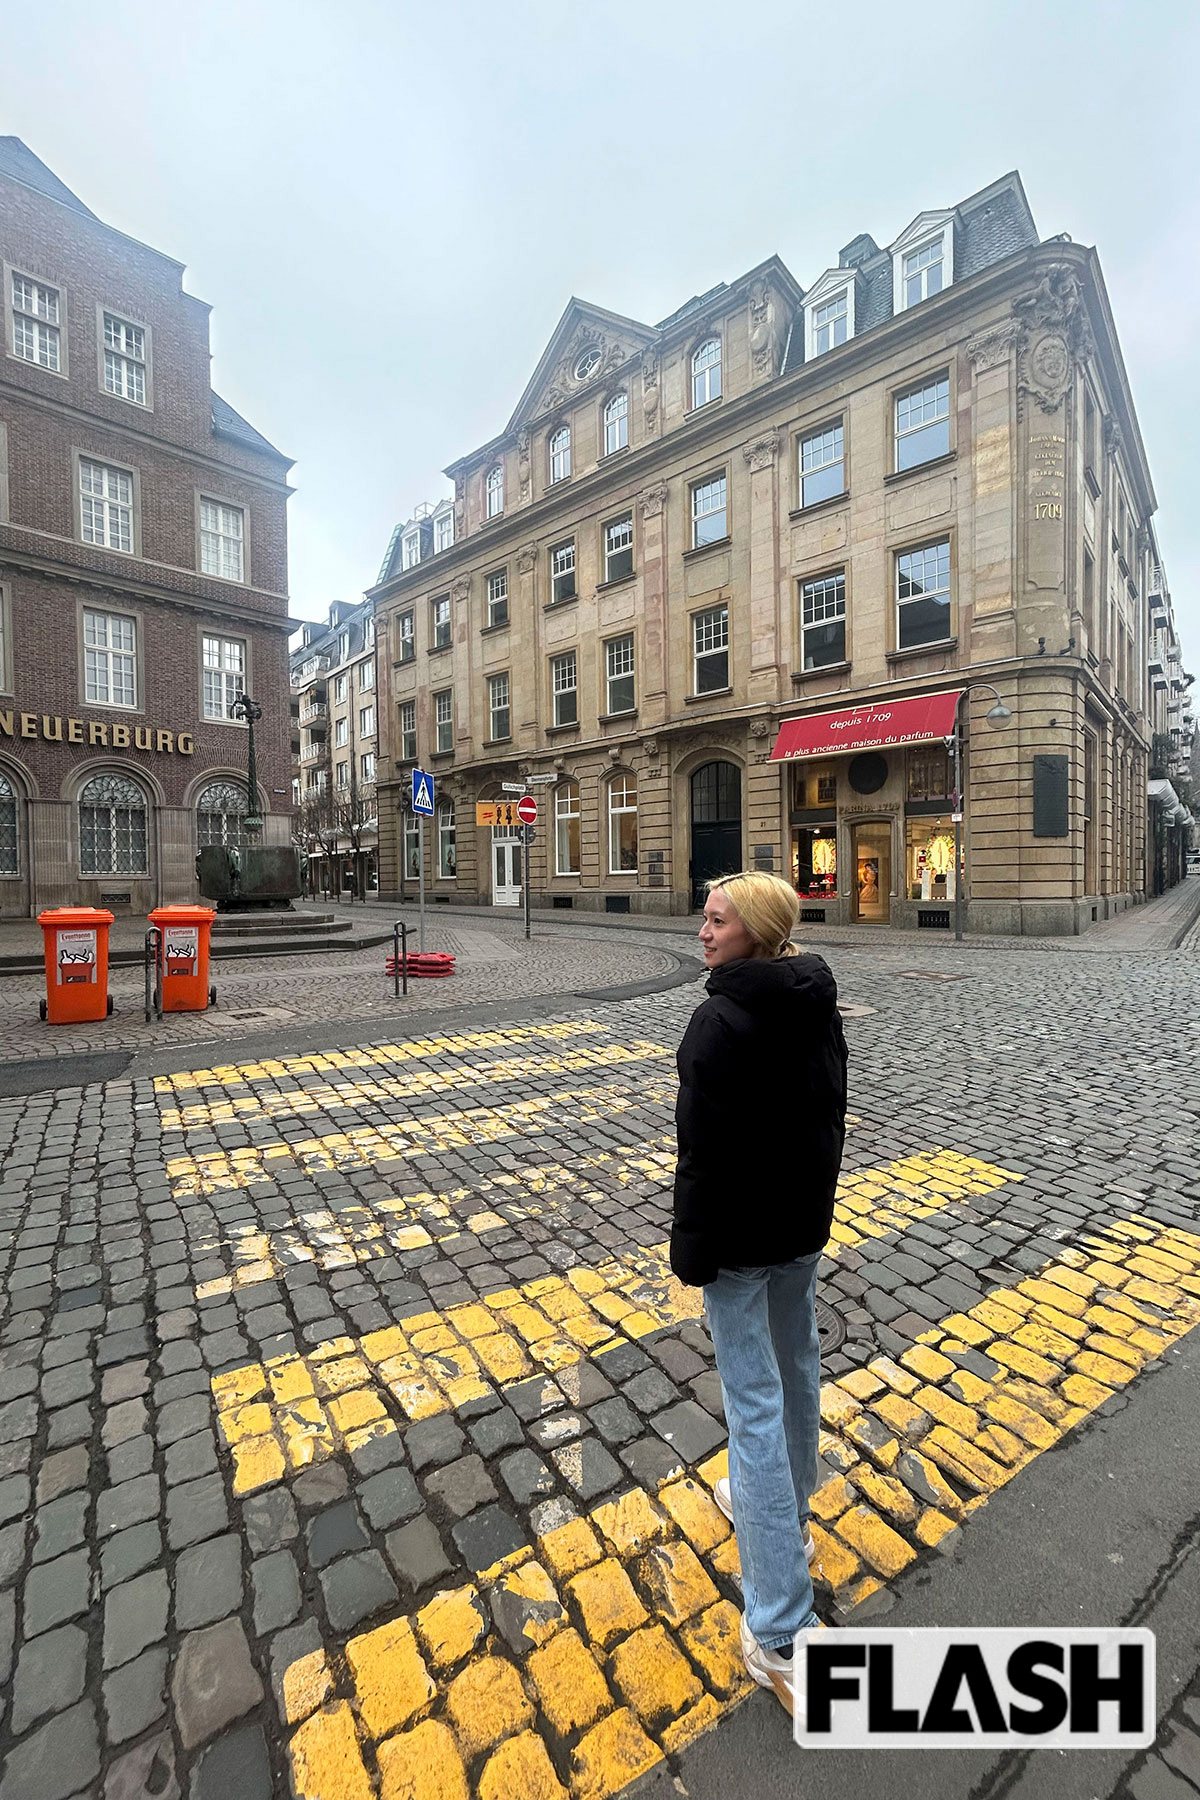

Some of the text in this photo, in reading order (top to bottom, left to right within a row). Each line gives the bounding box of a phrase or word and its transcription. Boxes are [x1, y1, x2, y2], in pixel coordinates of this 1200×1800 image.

[1034, 503, 1062, 520] 1709
[0, 710, 194, 755] NEUERBURG
[830, 712, 892, 731] depuis 1709
[784, 731, 934, 759] la plus ancienne maison du parfum
